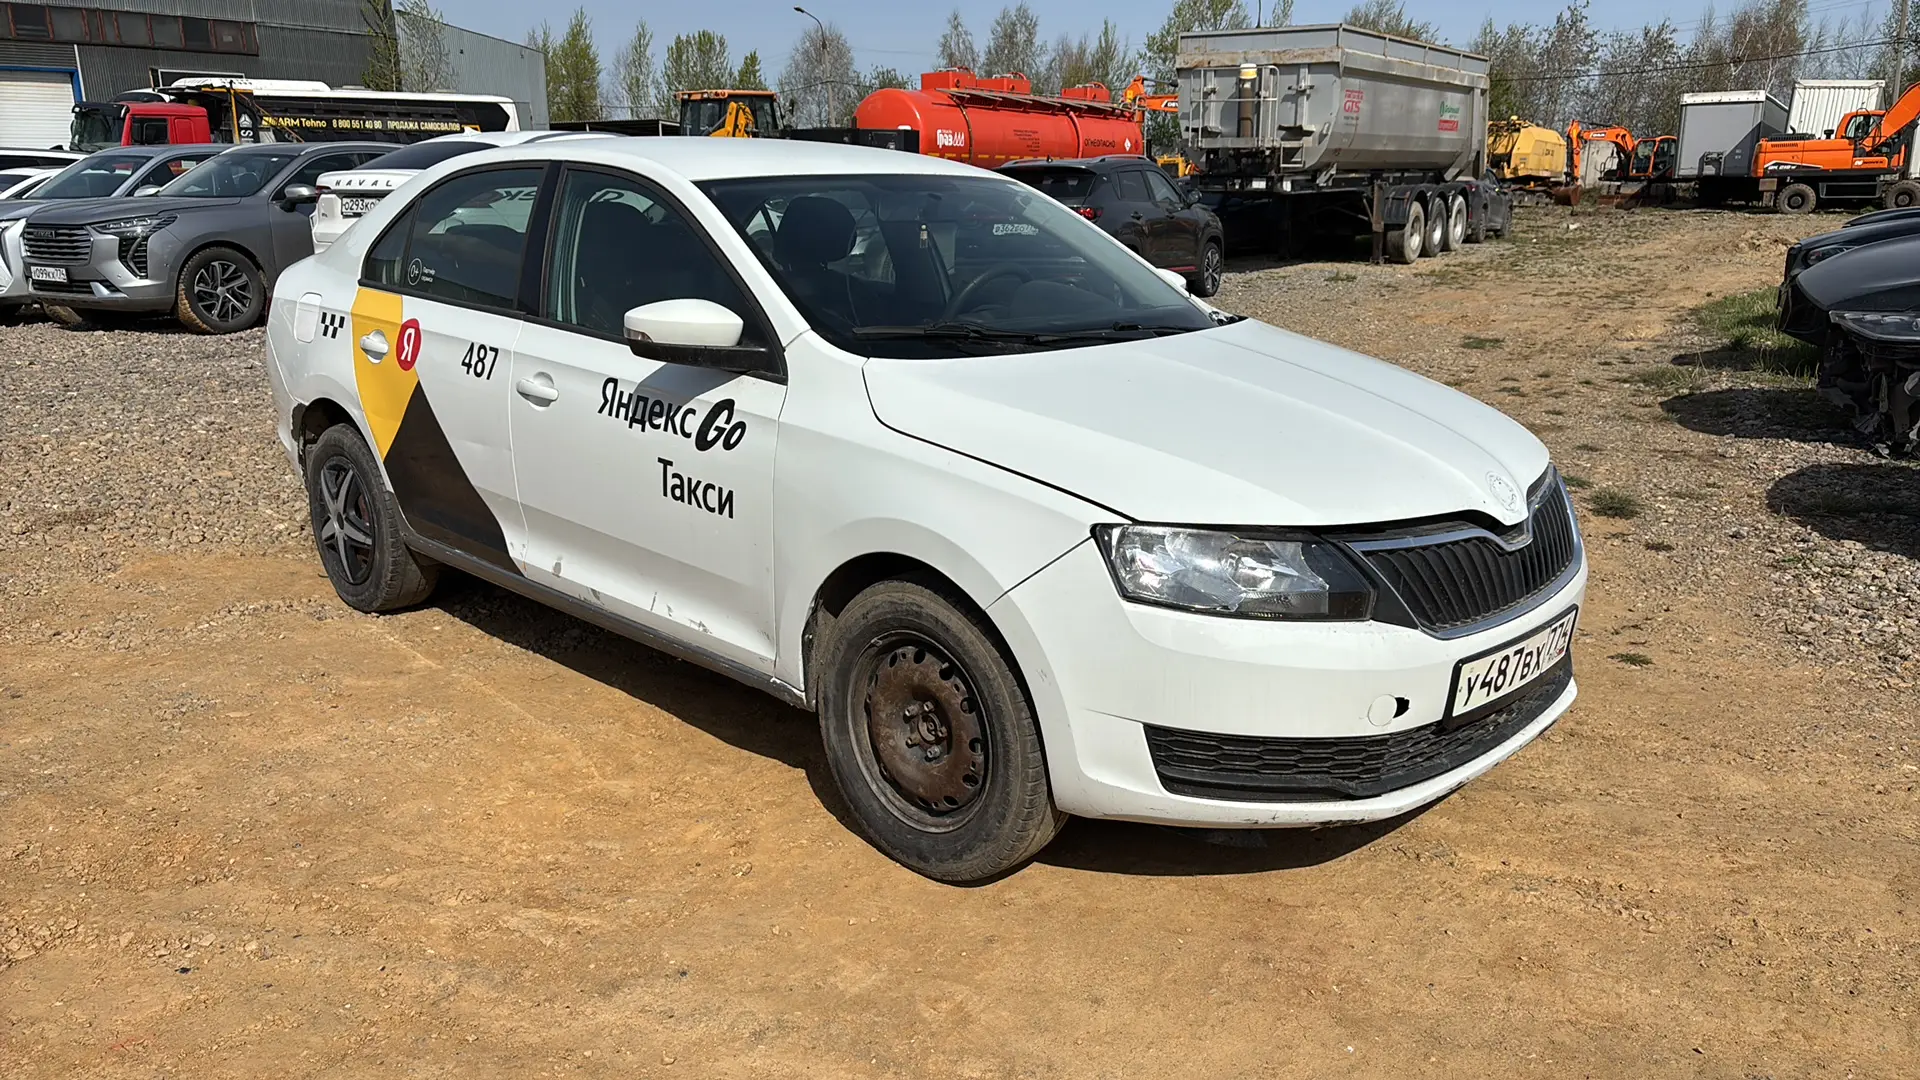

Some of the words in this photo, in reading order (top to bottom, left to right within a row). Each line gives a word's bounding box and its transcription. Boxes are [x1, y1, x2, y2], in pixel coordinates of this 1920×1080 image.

[300, 118, 327, 127] Tehno
[332, 119, 337, 127] 8
[352, 120, 364, 128] 551
[365, 120, 373, 129] 40
[387, 121, 419, 130] ПРОДАЖА
[420, 122, 461, 131] САМОСВАЛОВ
[335, 179, 393, 187] HAVAL
[400, 327, 416, 362] Я
[460, 342, 500, 381] 487
[597, 377, 697, 439] Яндекс
[694, 398, 747, 452] Go
[657, 456, 734, 519] Такси
